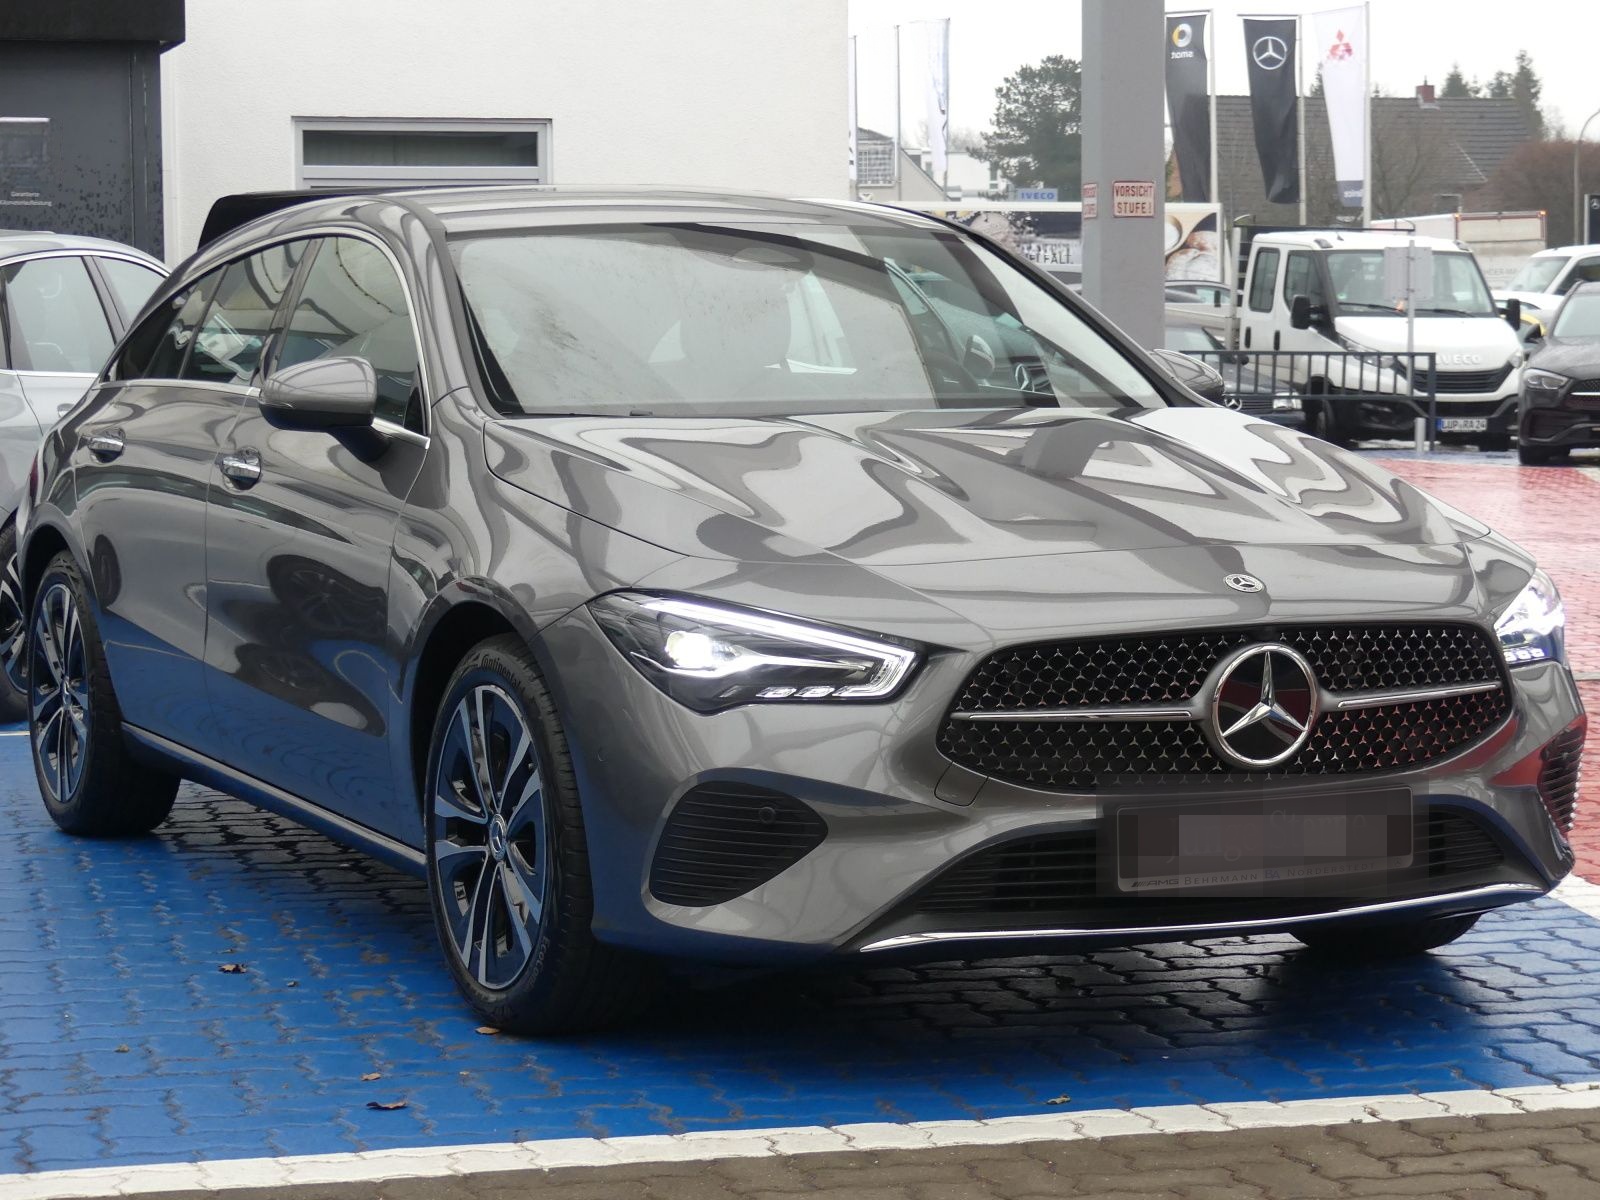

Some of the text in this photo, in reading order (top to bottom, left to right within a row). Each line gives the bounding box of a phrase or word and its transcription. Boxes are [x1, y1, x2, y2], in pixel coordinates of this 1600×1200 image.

[1021, 191, 1055, 200] IVECO
[1114, 185, 1153, 197] VORSICHT
[1147, 879, 1179, 887] AMG
[1184, 873, 1258, 886] BEHRMANN
[1287, 862, 1375, 878] NORDERSTEDT
